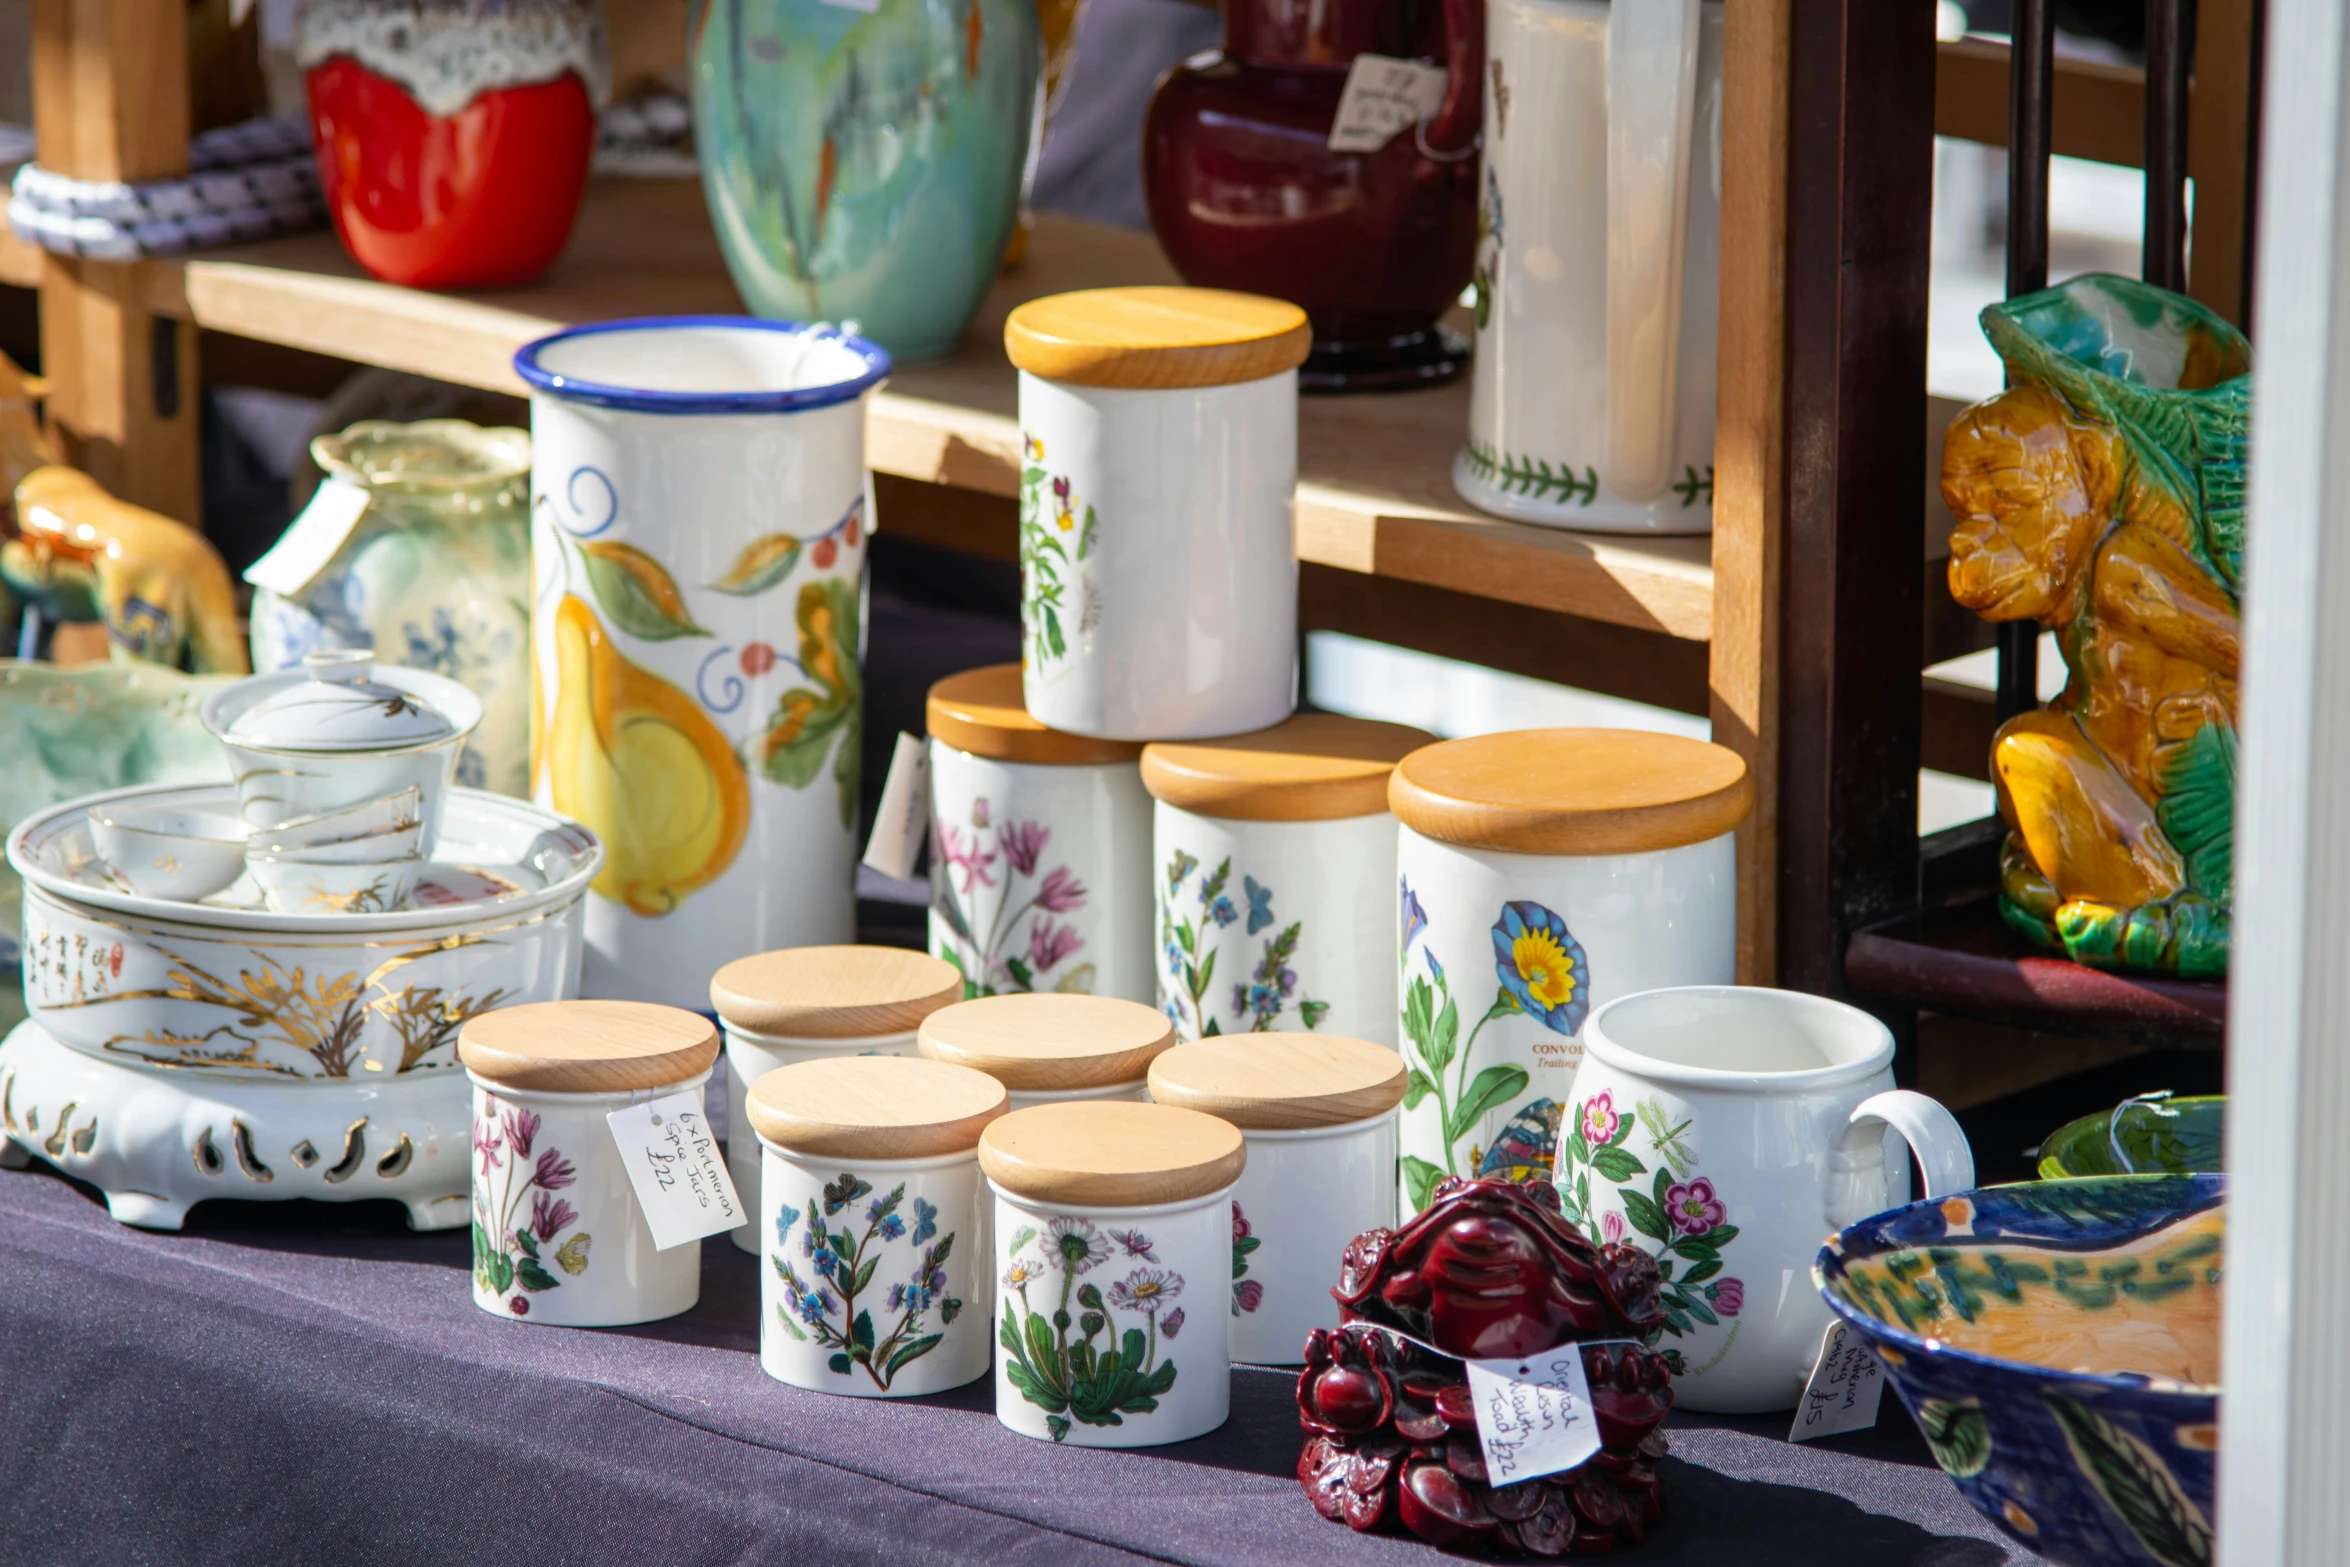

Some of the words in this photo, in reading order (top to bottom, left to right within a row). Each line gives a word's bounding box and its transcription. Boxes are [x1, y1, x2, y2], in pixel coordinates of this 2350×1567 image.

[1537, 1057, 1578, 1070] Trailing
[646, 1146, 676, 1192] £22
[664, 1122, 687, 1163] Spice
[686, 1164, 710, 1208] Jars
[1693, 1319, 1742, 1377] Rhododendron
[1830, 1347, 1857, 1384] Mug
[1489, 1387, 1518, 1433] Toad
[1508, 1379, 1535, 1441] Wealth
[1536, 1381, 1554, 1430] Resin
[1551, 1360, 1579, 1430] Oriental
[1806, 1389, 1839, 1426] £15
[1488, 1438, 1524, 1477] £22
